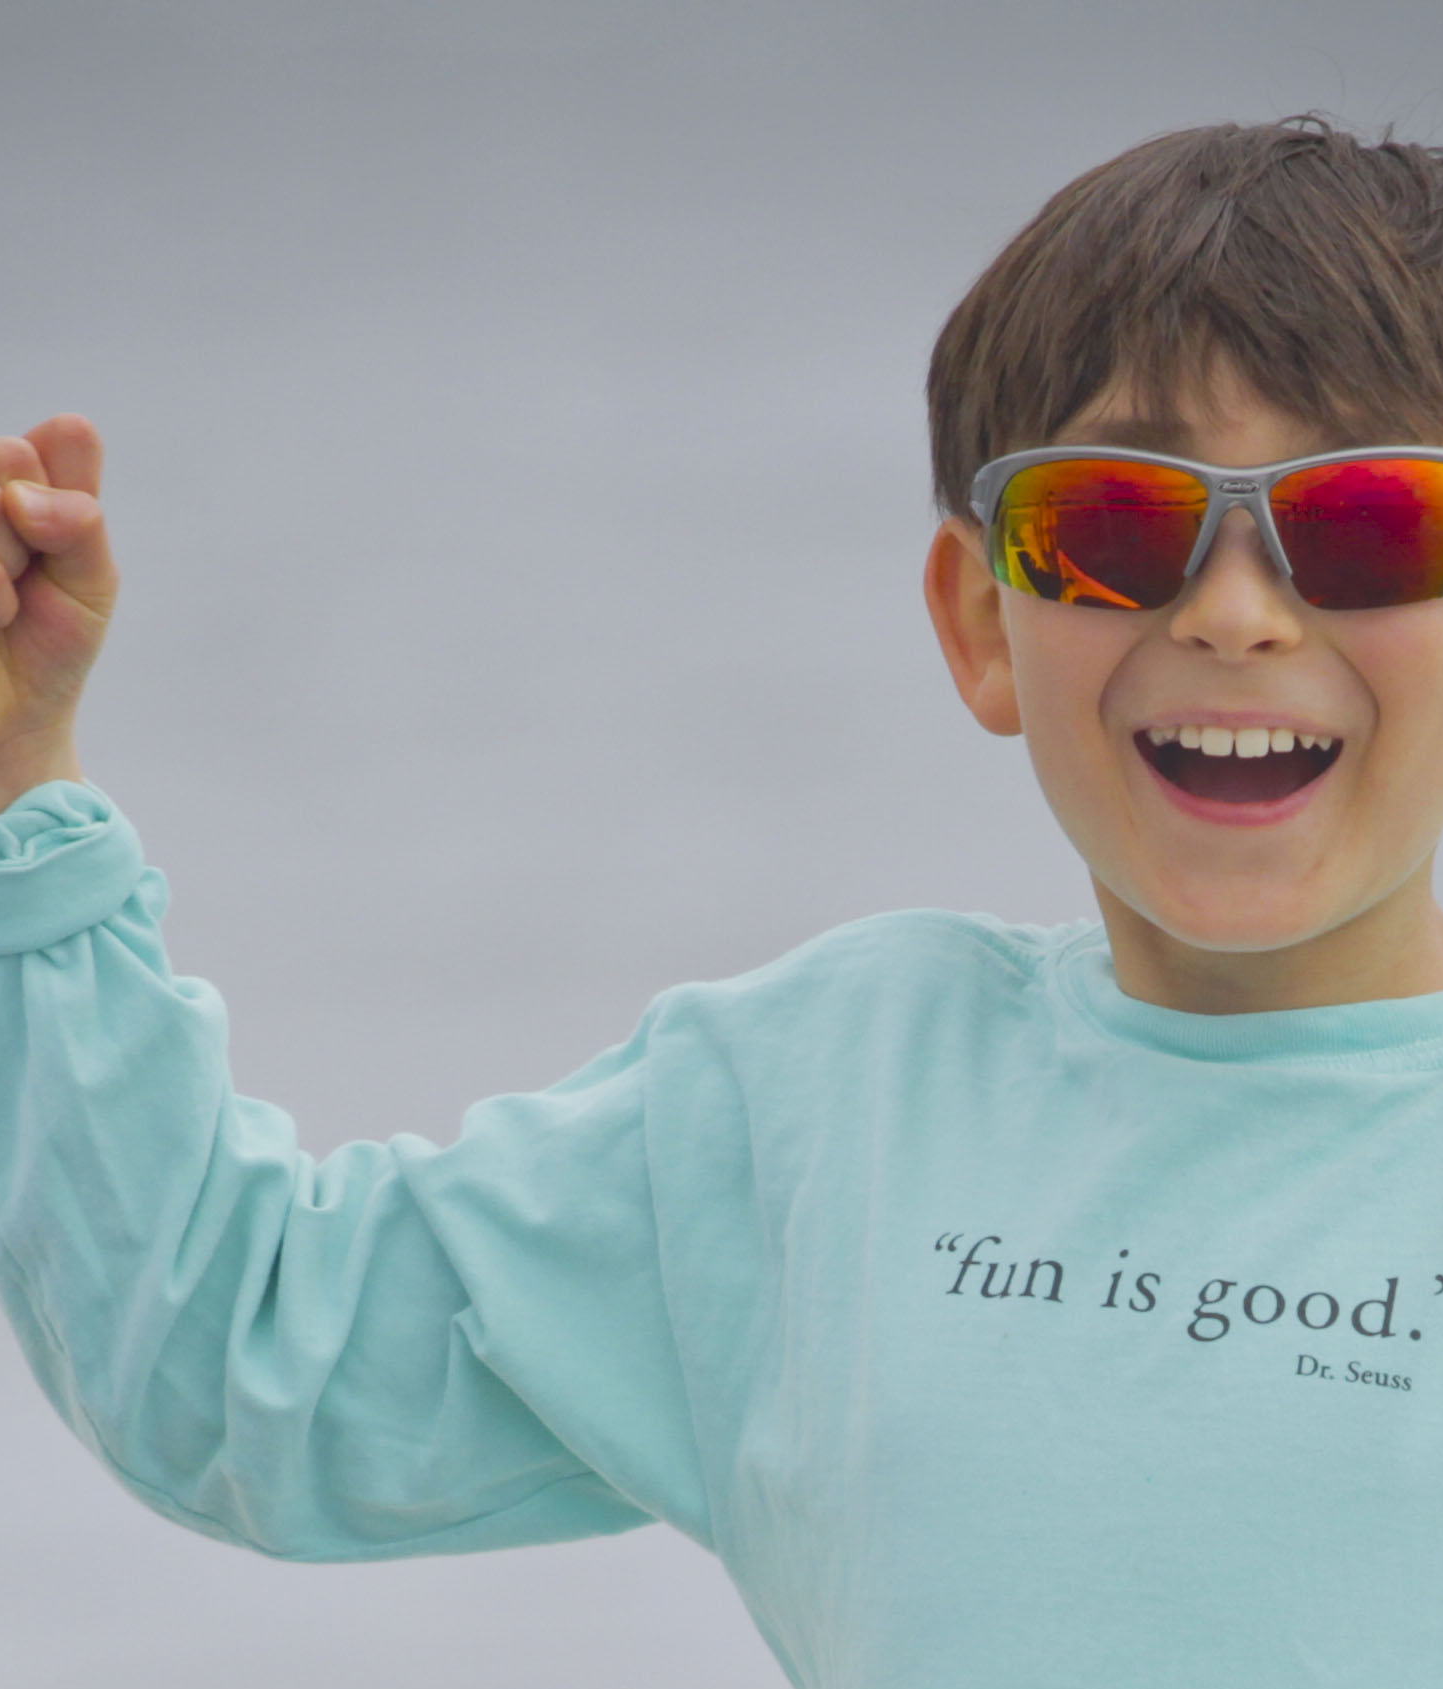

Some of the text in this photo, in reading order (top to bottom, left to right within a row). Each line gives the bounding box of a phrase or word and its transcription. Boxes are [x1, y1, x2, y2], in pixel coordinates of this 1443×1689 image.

[934, 1231, 1065, 1304] “fun
[1100, 1248, 1162, 1313] is
[1295, 1353, 1413, 1392] Dr. Seuss
